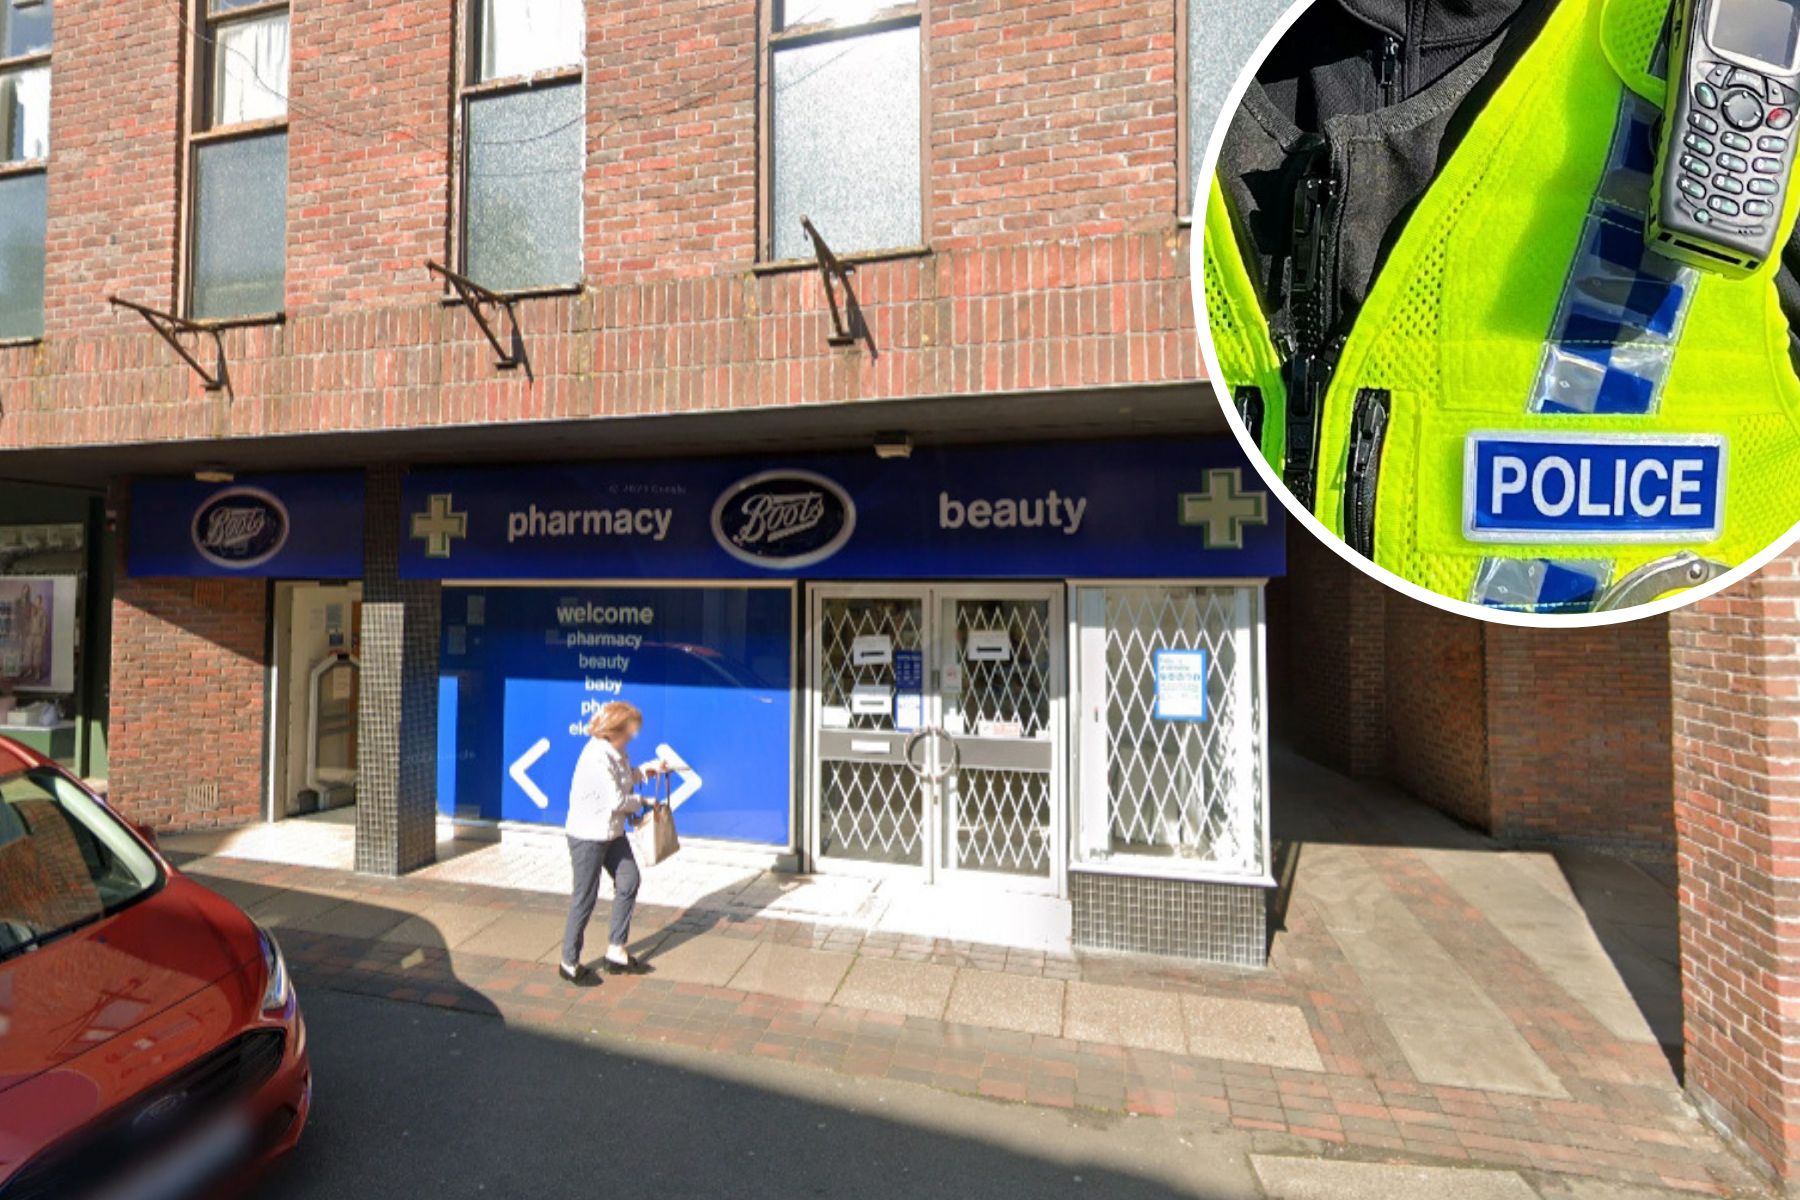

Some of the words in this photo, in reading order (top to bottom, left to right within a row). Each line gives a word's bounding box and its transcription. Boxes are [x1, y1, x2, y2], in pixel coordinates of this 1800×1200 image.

[1491, 455, 1704, 517] POLICE
[199, 507, 265, 547] Boots
[507, 503, 673, 543] pharmacy
[732, 491, 825, 546] Boots
[938, 489, 1088, 535] beauty
[556, 601, 655, 625] welcome
[566, 630, 643, 651] pharmacy
[578, 652, 631, 673] beauty
[584, 675, 623, 695] baby
